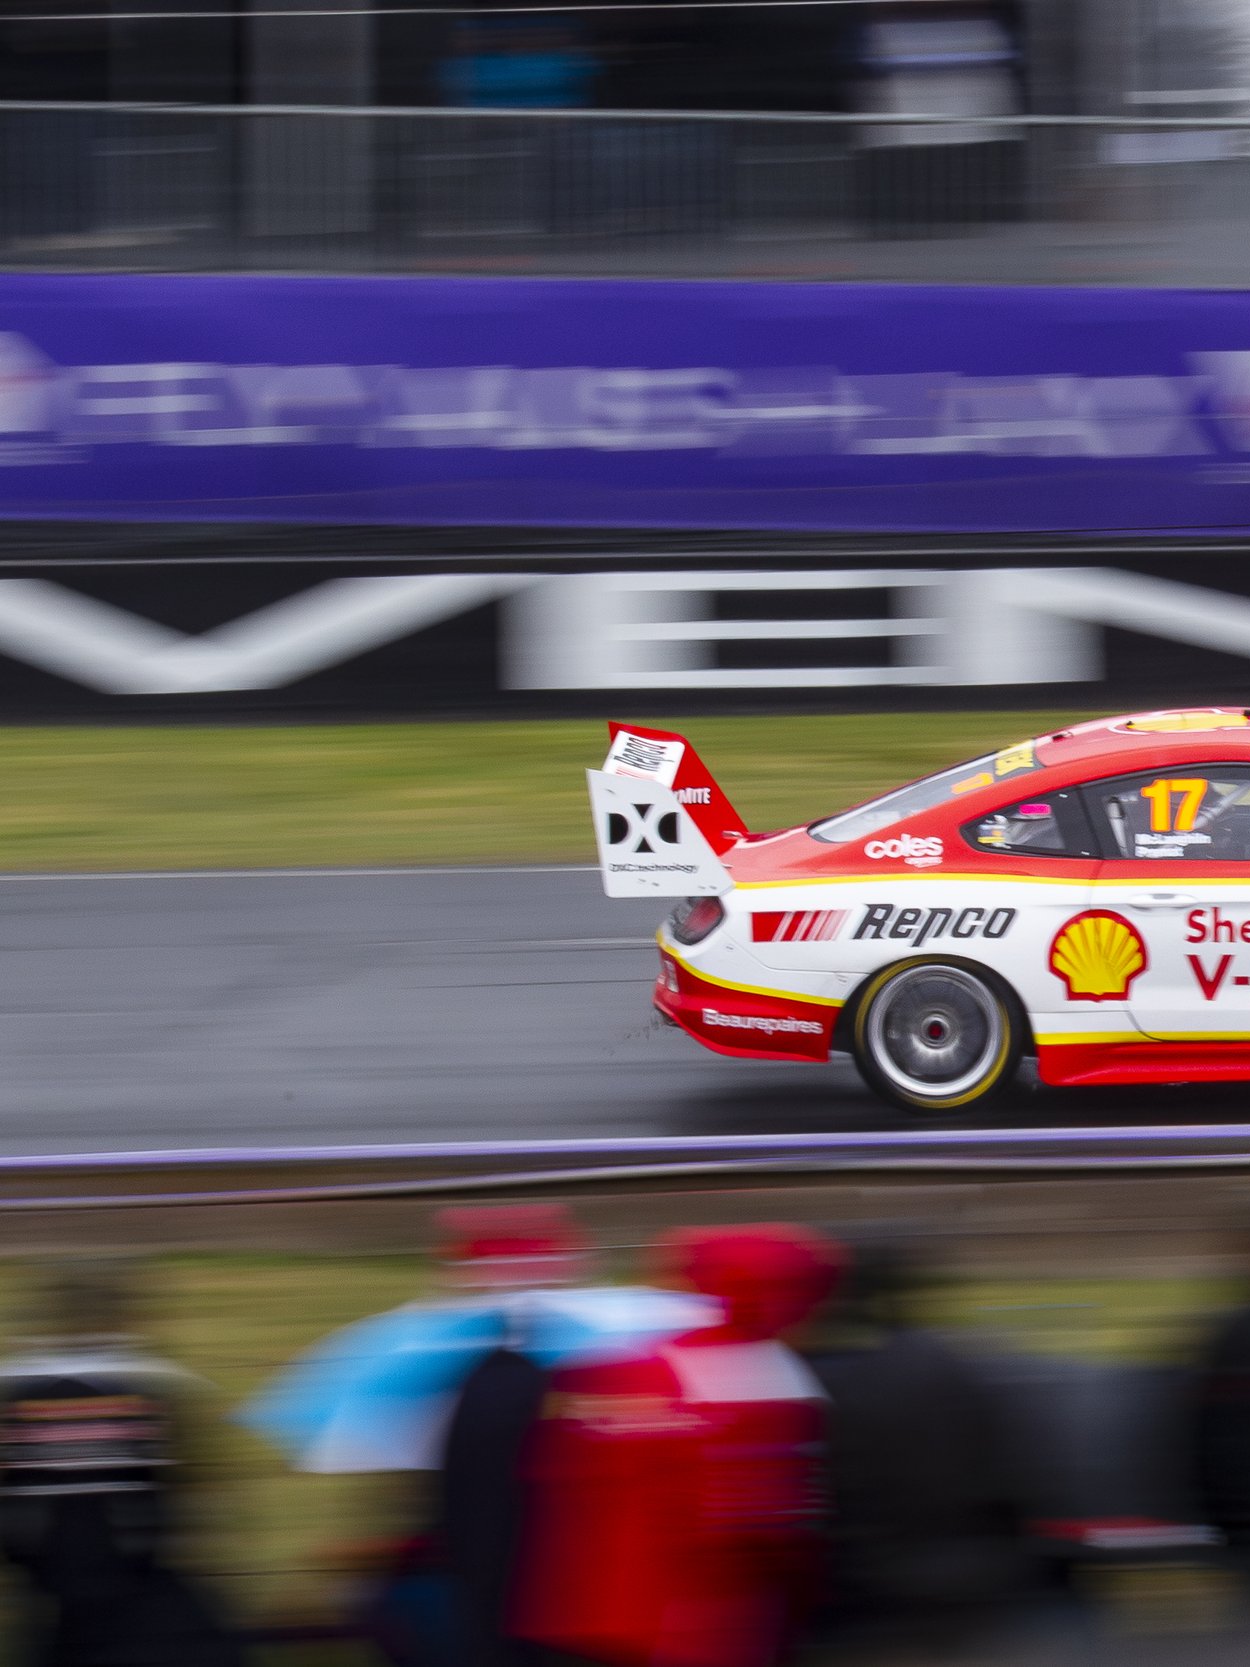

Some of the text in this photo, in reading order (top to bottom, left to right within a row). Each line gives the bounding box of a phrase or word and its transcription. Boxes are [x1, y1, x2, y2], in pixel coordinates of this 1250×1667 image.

[1141, 778, 1208, 832] 17
[864, 834, 944, 859] coles
[851, 903, 1017, 947] Repco
[702, 1008, 824, 1035] Beaurepaires
